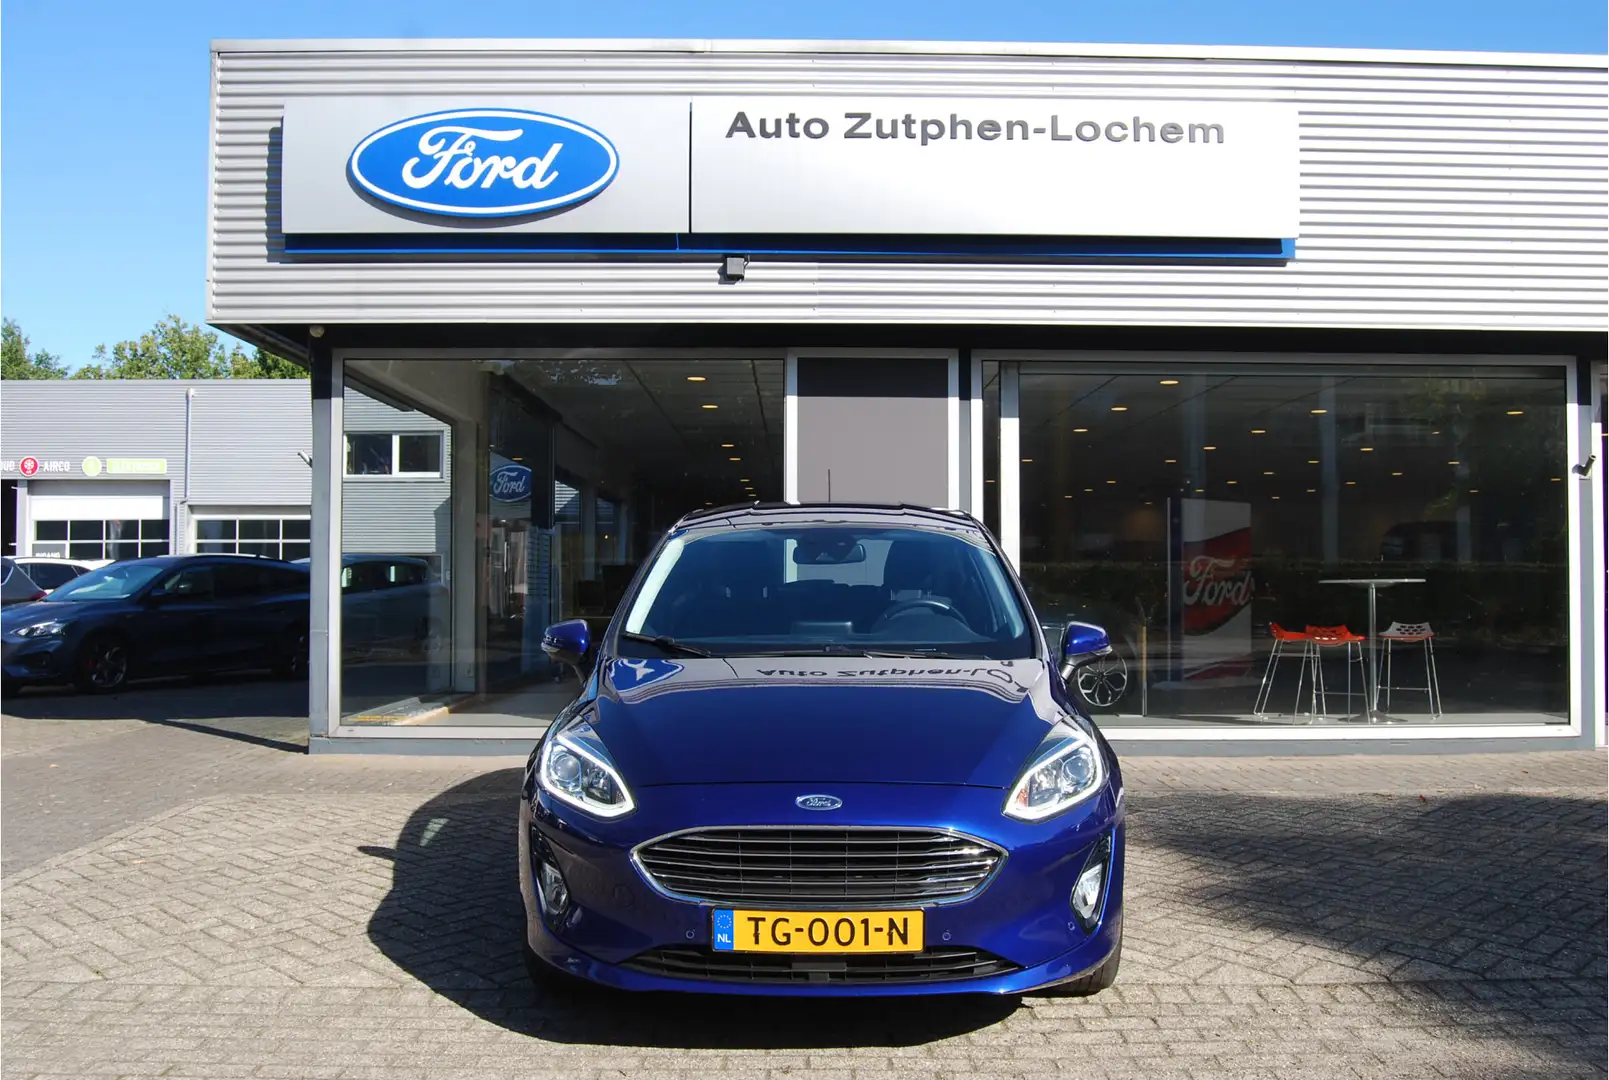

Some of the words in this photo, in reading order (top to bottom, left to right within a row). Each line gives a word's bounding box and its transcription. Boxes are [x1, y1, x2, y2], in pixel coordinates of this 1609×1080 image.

[725, 111, 830, 139] Auto
[843, 112, 1225, 146] Zutphen-Lochem
[401, 125, 564, 189] Ford
[43, 460, 70, 472] AIRCO
[493, 471, 526, 494] Ford
[1183, 555, 1254, 606] Ford
[717, 933, 731, 943] NL
[747, 917, 909, 946] TG-001-N
